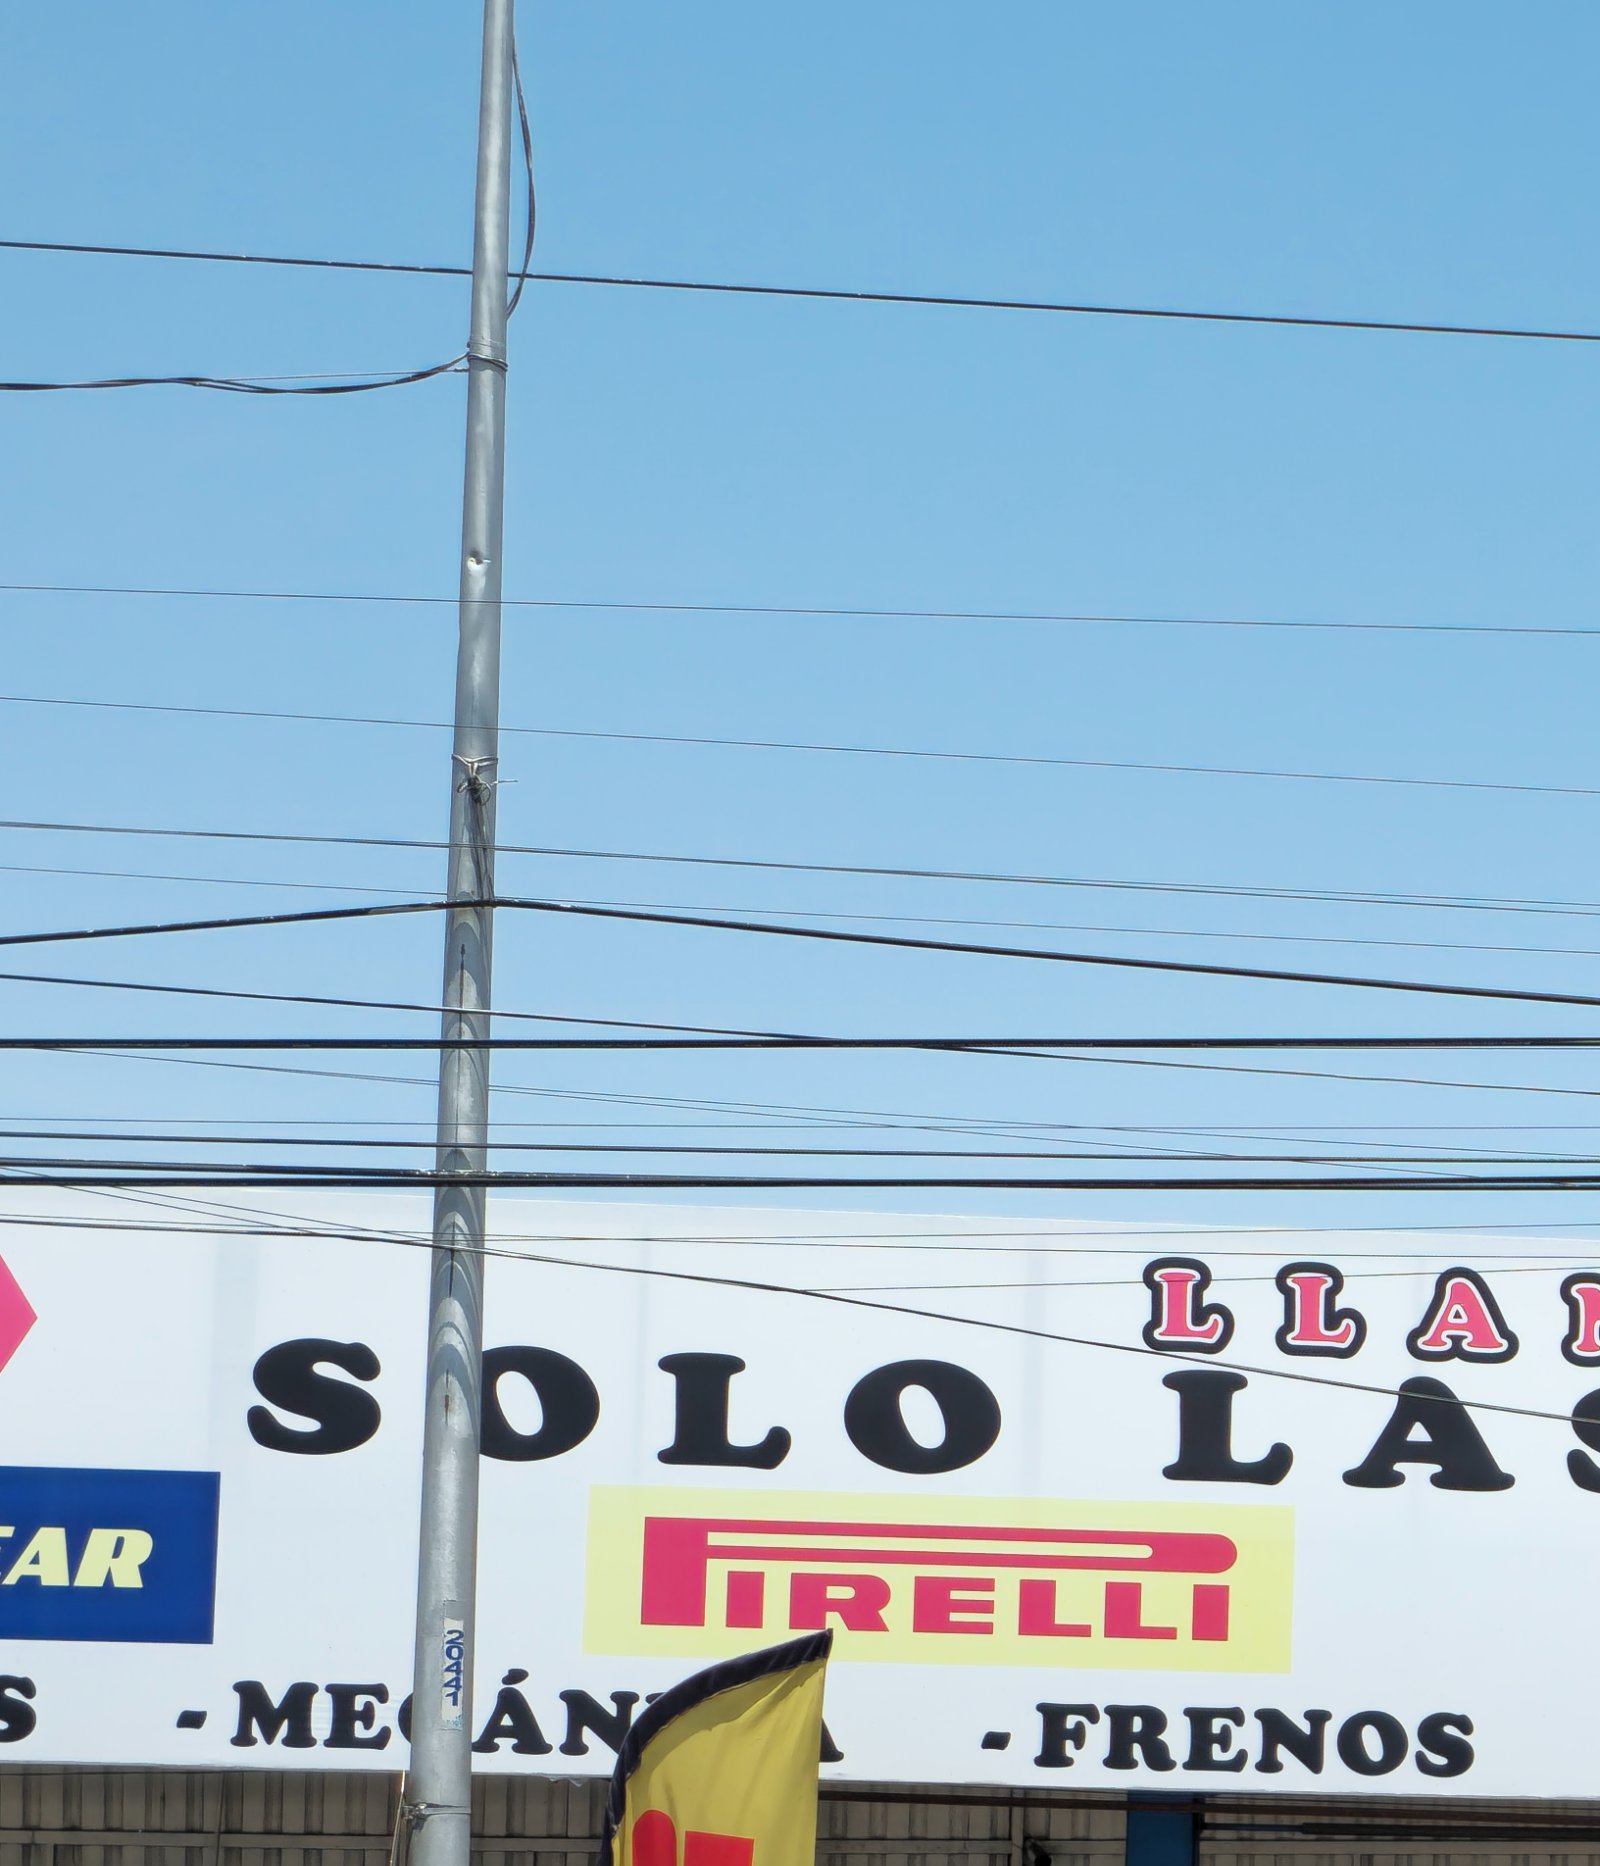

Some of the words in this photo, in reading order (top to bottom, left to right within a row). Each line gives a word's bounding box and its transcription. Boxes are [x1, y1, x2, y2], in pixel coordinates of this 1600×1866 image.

[247, 1338, 1002, 1475] SOLO
[640, 1516, 1238, 1641] PIRELLI
[1034, 1702, 1475, 1778] FRENOS
